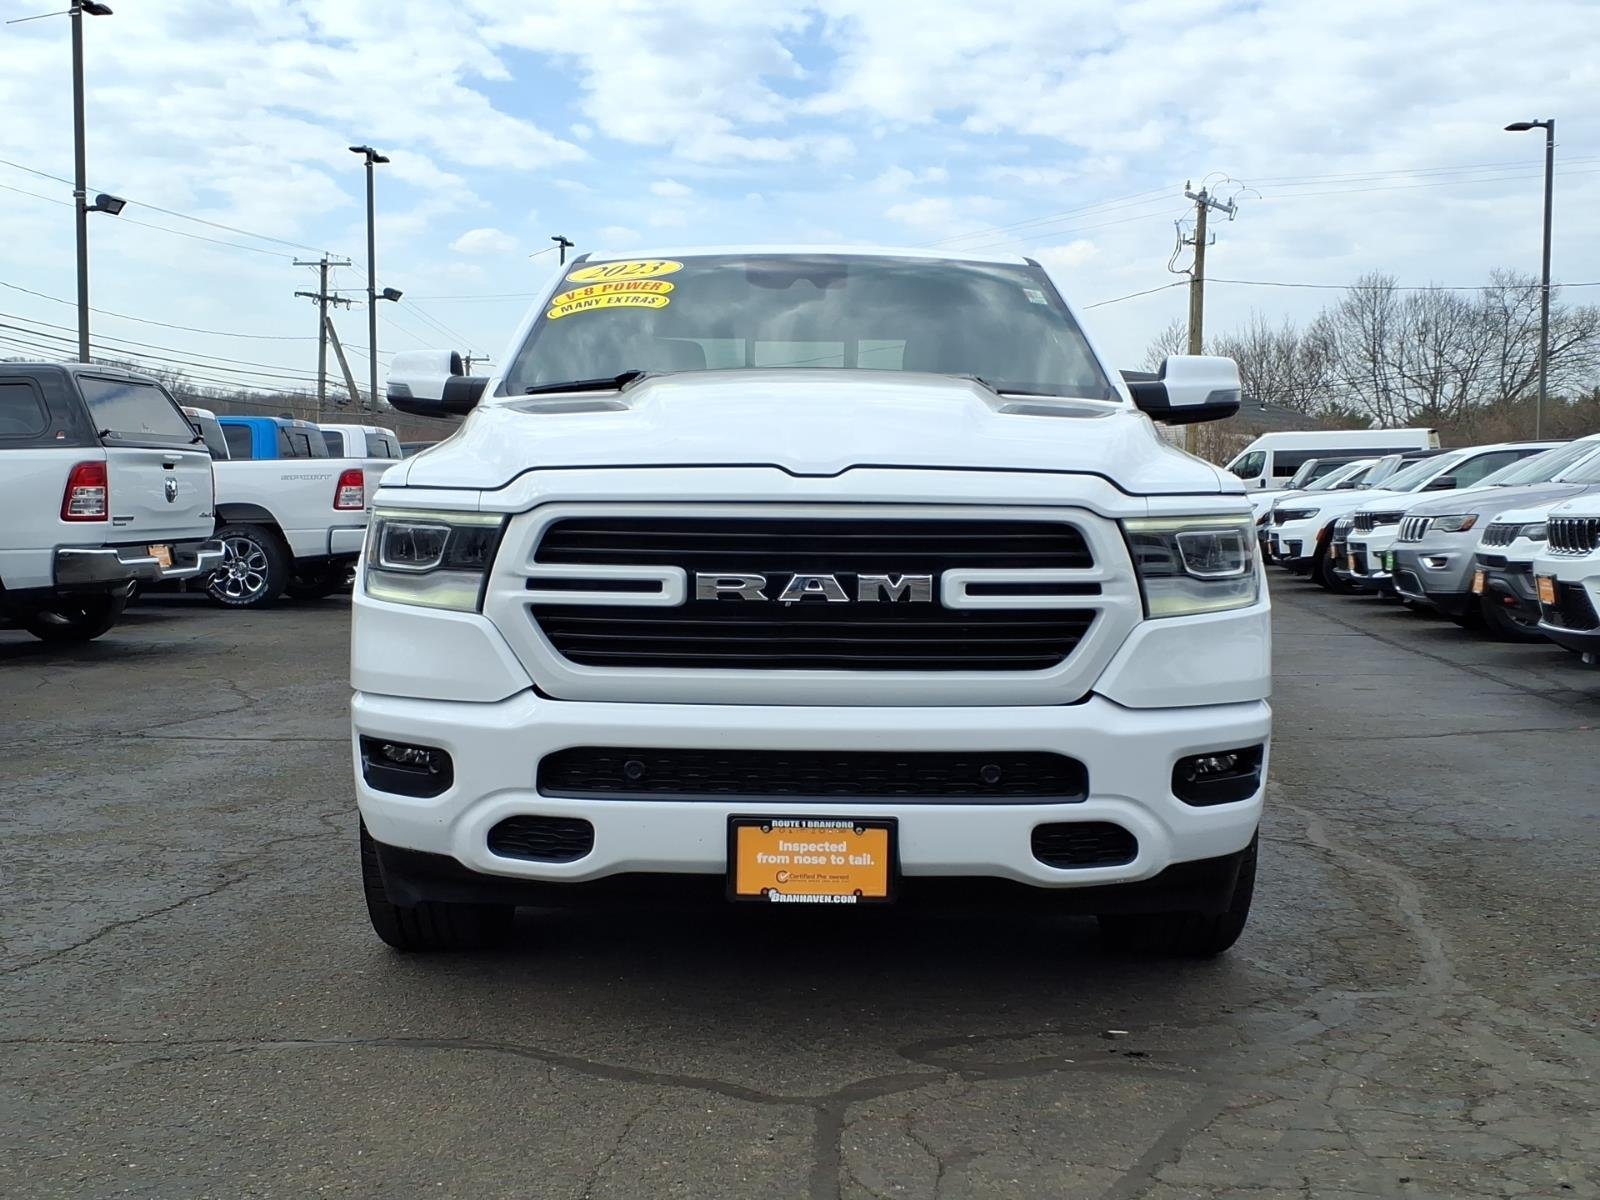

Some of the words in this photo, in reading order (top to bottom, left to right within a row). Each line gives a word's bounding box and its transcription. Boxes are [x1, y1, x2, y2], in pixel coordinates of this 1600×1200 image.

[582, 261, 667, 280] 2023
[565, 287, 594, 300] V-8
[601, 281, 664, 293] POWER
[560, 298, 602, 313] MANY
[606, 295, 659, 305] EXTRAS
[696, 572, 933, 602] RAM
[771, 820, 801, 828] ROUTE
[807, 820, 854, 828] BRANFORD
[778, 840, 847, 854] Inspected
[756, 852, 790, 864] from
[793, 854, 827, 865] nose
[830, 854, 845, 865] to
[848, 853, 875, 865] tail.
